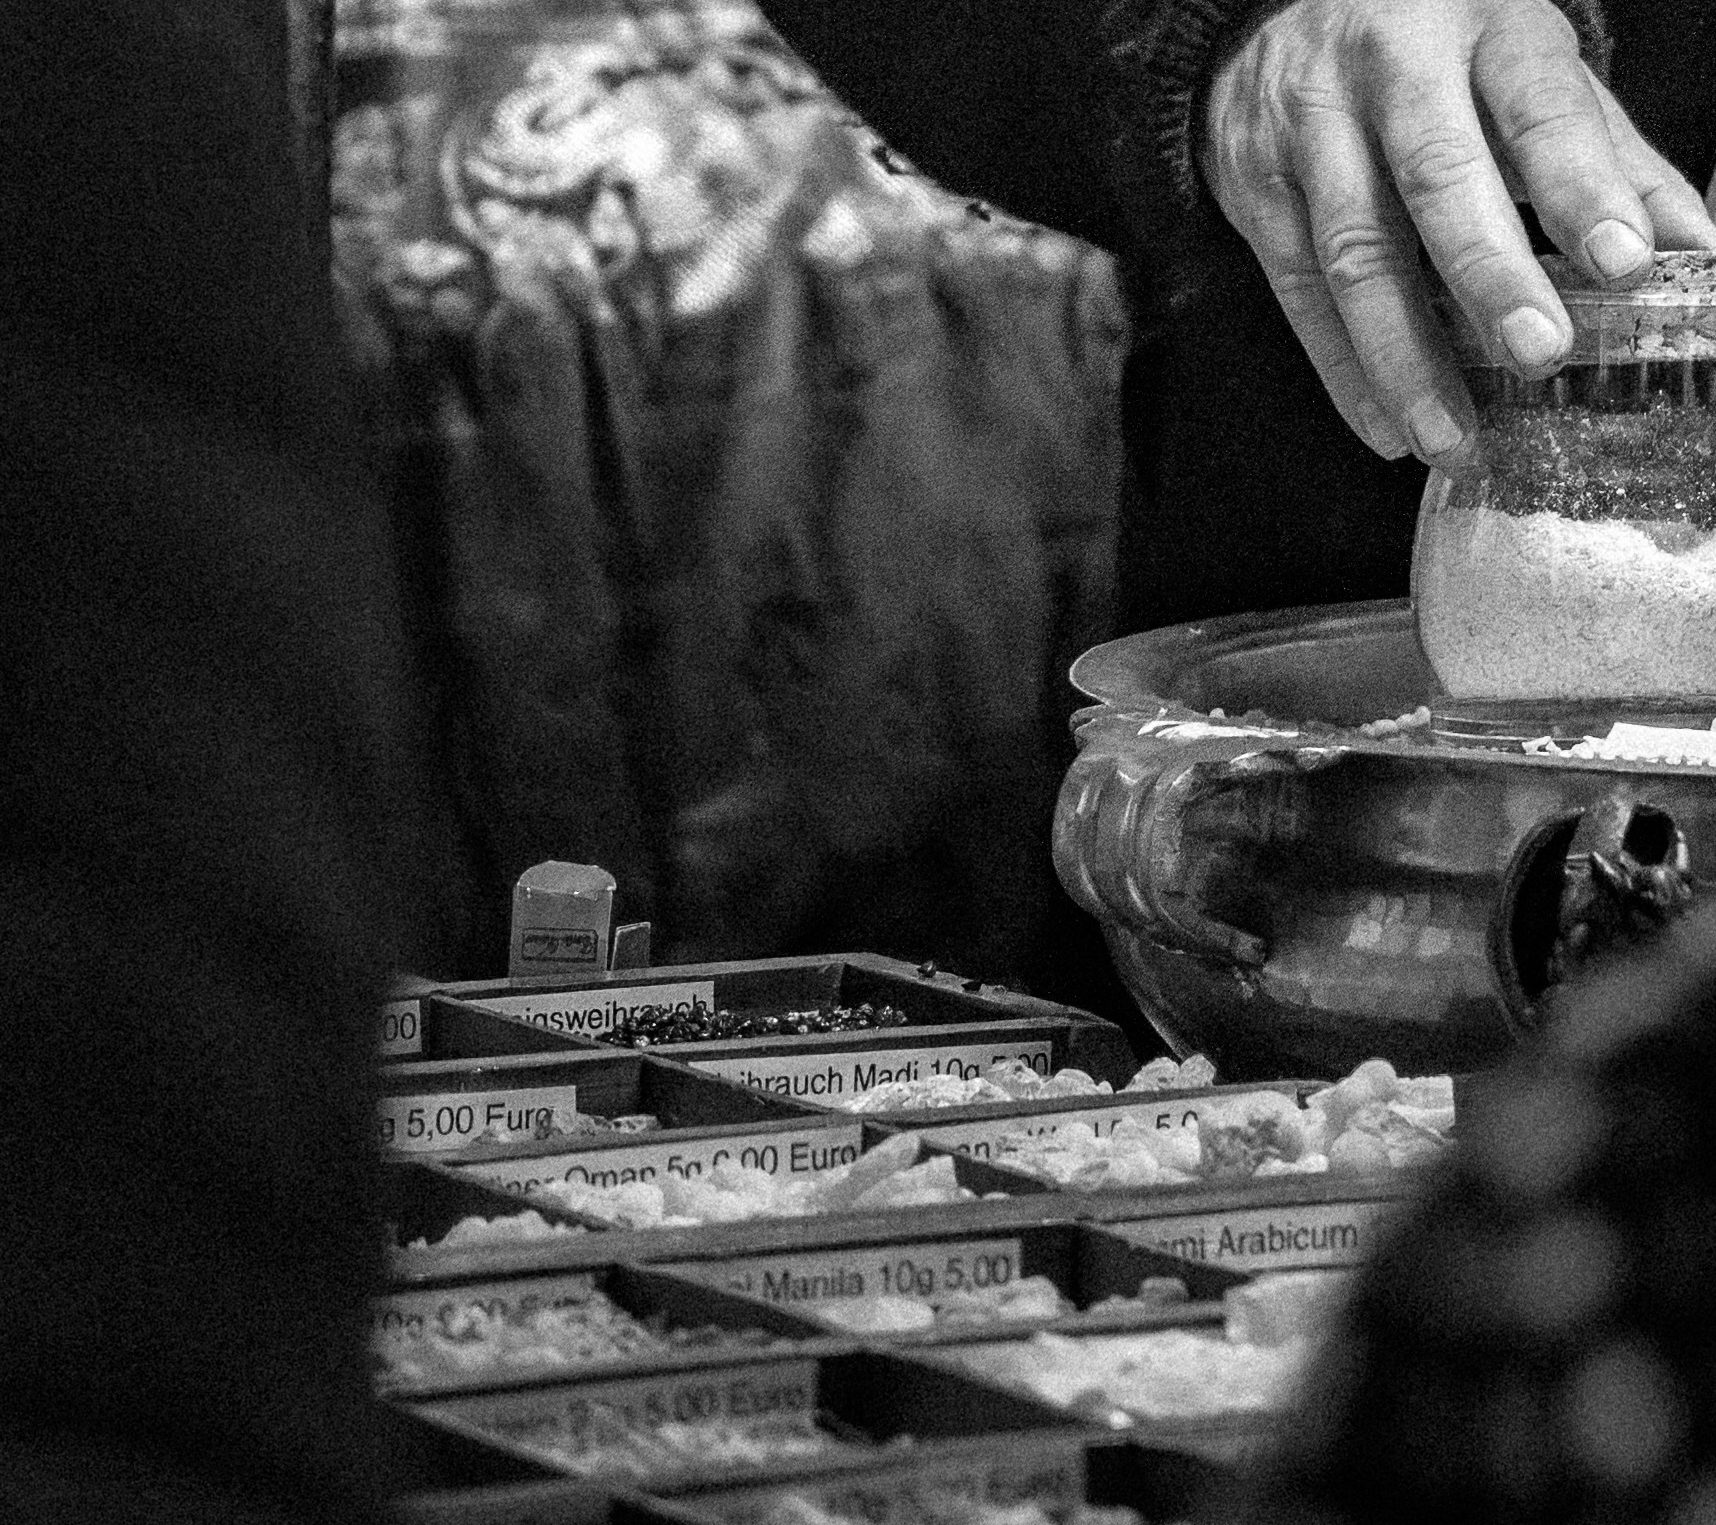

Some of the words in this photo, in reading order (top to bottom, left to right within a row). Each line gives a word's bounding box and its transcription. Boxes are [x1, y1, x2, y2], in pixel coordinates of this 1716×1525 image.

[407, 1105, 474, 1142] 5,00
[789, 1141, 858, 1173] Euro
[1217, 1221, 1359, 1257] Arabicum
[879, 1258, 935, 1296] 10g
[945, 1253, 1012, 1294] 5,00
